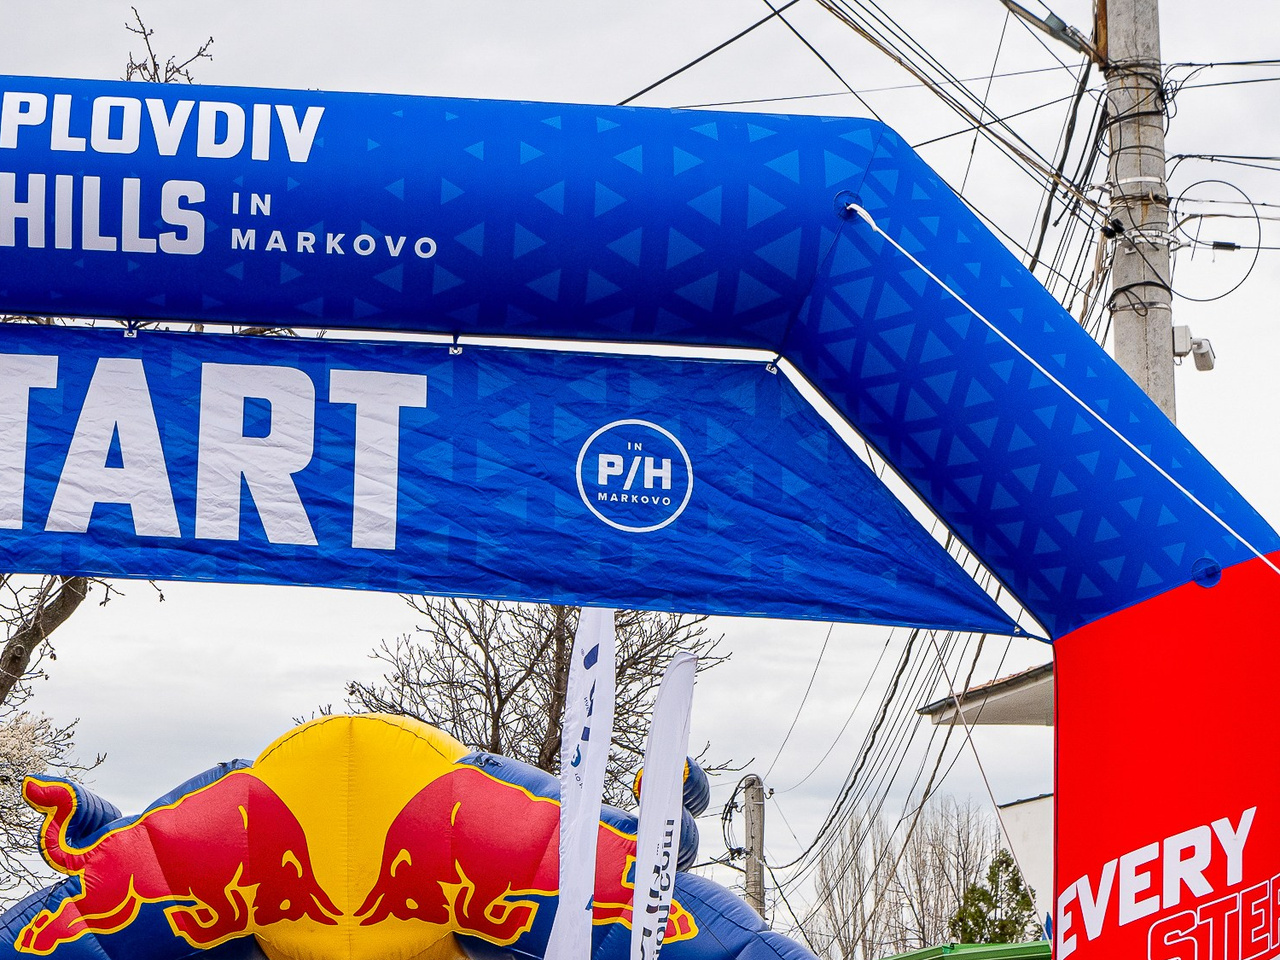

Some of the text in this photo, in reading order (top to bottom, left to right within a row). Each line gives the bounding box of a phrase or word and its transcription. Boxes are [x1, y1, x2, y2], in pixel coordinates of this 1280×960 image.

[0, 91, 325, 163] PLOVDIV
[231, 192, 272, 217] IN
[230, 229, 438, 259] MARKOVO
[627, 442, 642, 451] IN
[598, 453, 672, 491] P/H
[597, 492, 671, 506] MARKOVO
